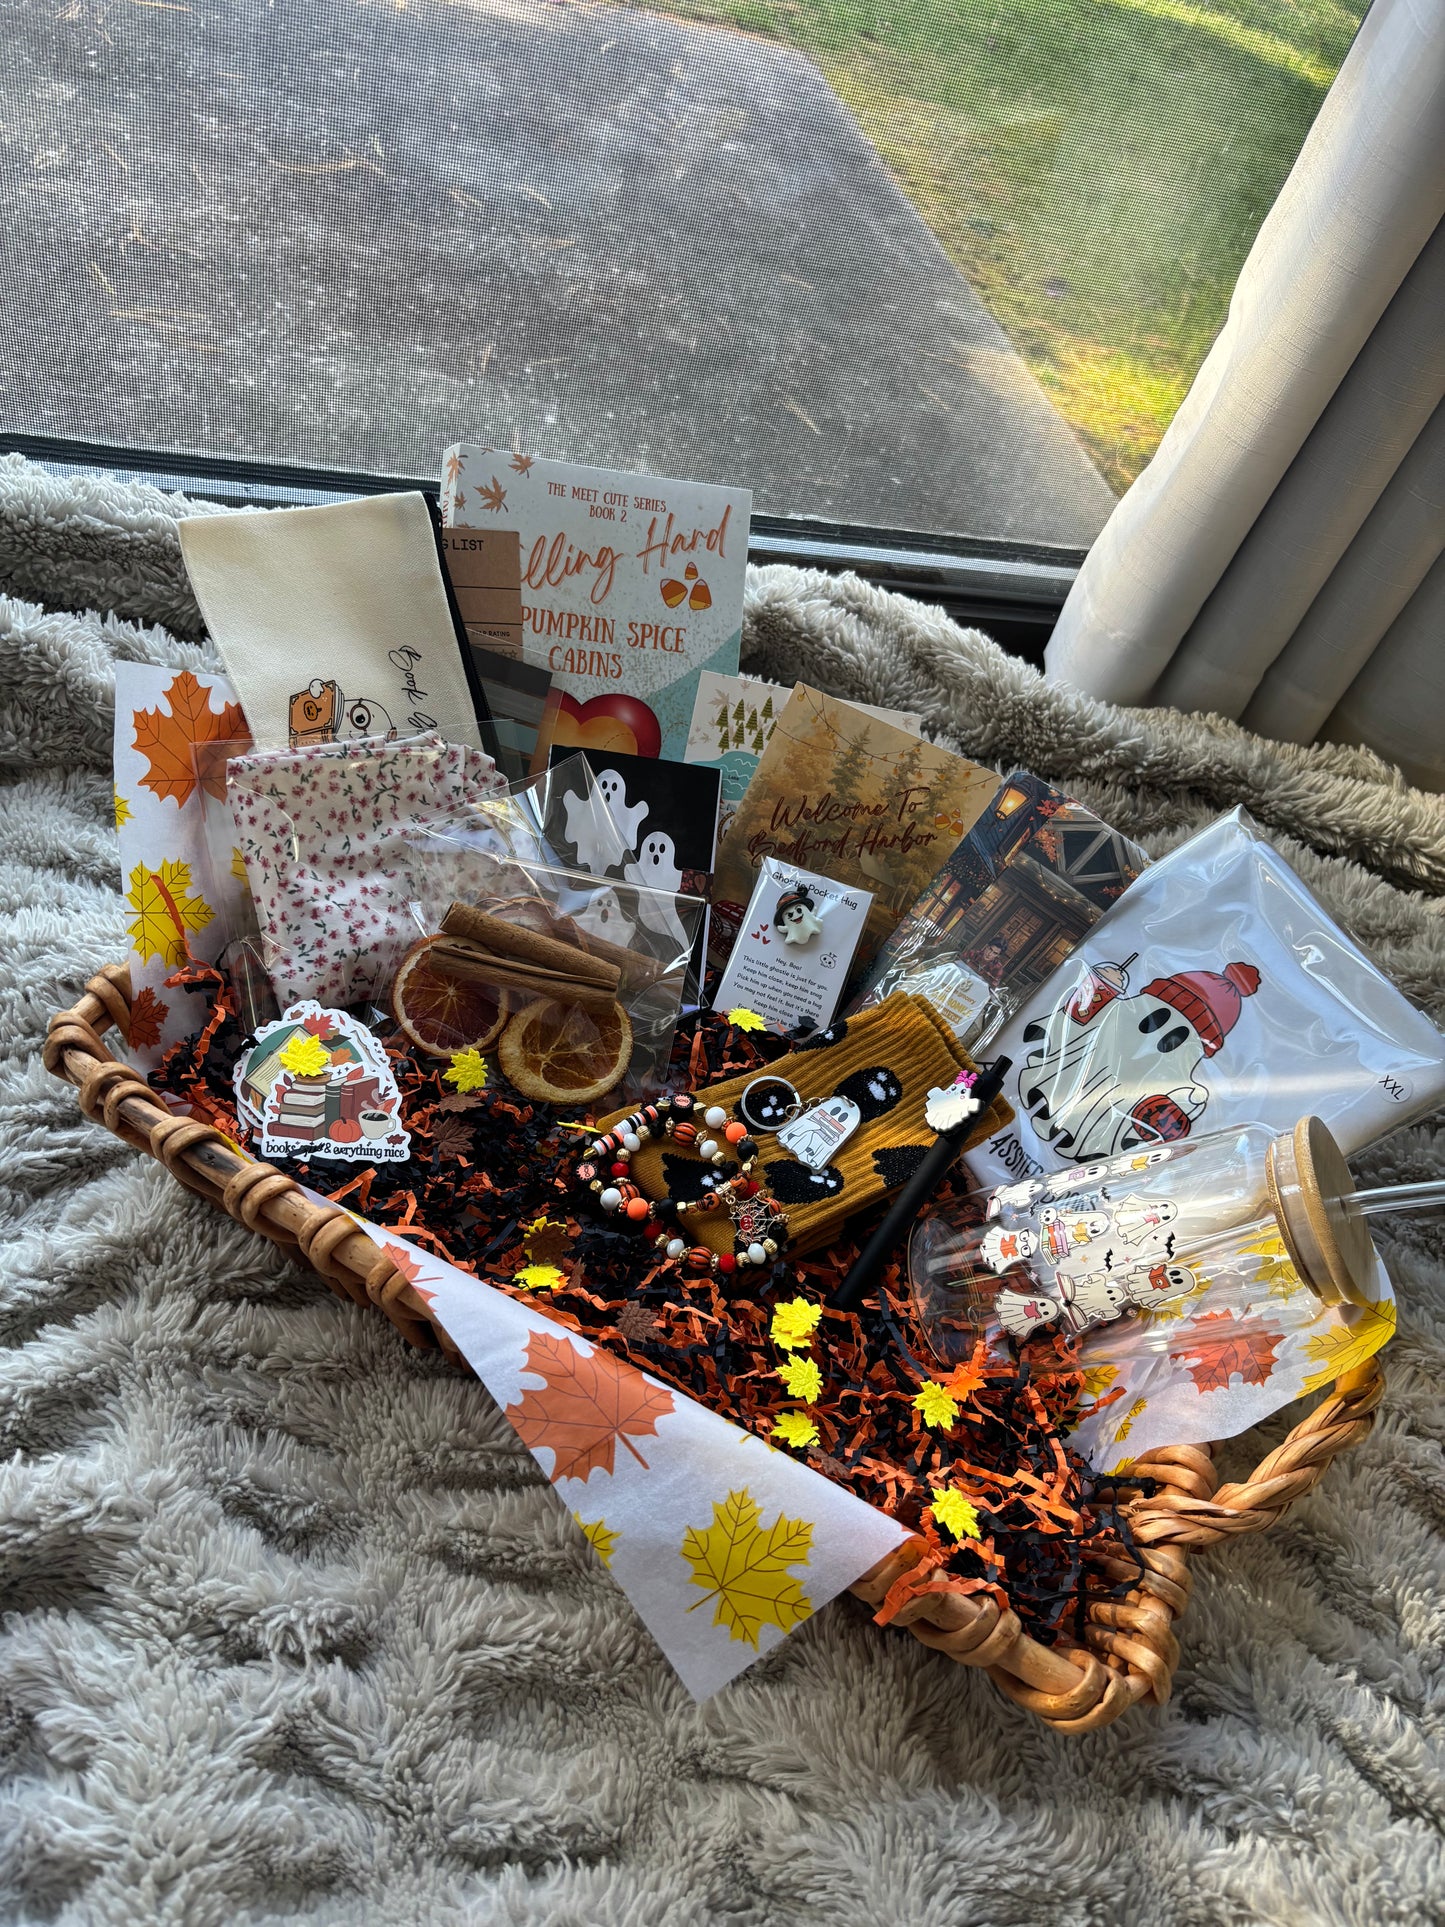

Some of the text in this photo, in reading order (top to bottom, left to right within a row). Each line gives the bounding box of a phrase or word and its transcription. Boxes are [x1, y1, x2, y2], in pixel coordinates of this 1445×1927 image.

[547, 482, 667, 513] THE MEET CUTE SERIES
[589, 505, 628, 523] BOOK 2
[452, 538, 484, 551] LIST
[520, 504, 733, 605] lling Hard
[521, 605, 687, 654] PUMPKIN SPICE
[388, 645, 429, 706] Book
[549, 645, 623, 680] CABINS
[770, 792, 889, 832] Welcome
[895, 786, 930, 822] To
[747, 827, 851, 868] Bedford
[855, 821, 938, 858] Harbor
[808, 884, 839, 902] Pocket
[841, 896, 858, 911] Hug
[743, 954, 755, 964] This
[756, 959, 769, 969] little
[769, 965, 789, 977] ghostie
[795, 974, 808, 983] just
[807, 978, 817, 986] for
[743, 965, 757, 974] Keep
[757, 970, 768, 978] him
[785, 981, 799, 991] keep
[799, 985, 809, 994] him
[809, 991, 823, 1000] snug
[733, 981, 744, 990] You
[744, 986, 756, 995] may
[766, 993, 778, 1002] feel
[785, 1000, 795, 1008] but
[804, 1008, 820, 1018] there
[737, 972, 749, 982] Pick
[749, 977, 760, 985] him
[768, 984, 783, 994] when
[782, 991, 793, 999] you
[793, 994, 807, 1003] need
[812, 1000, 822, 1010] hug
[753, 999, 794, 1018] Keep him close
[1378, 1075, 1404, 1100] XXL
[324, 1142, 332, 1153] &
[333, 1142, 383, 1158] everything
[384, 1144, 405, 1158] nice
